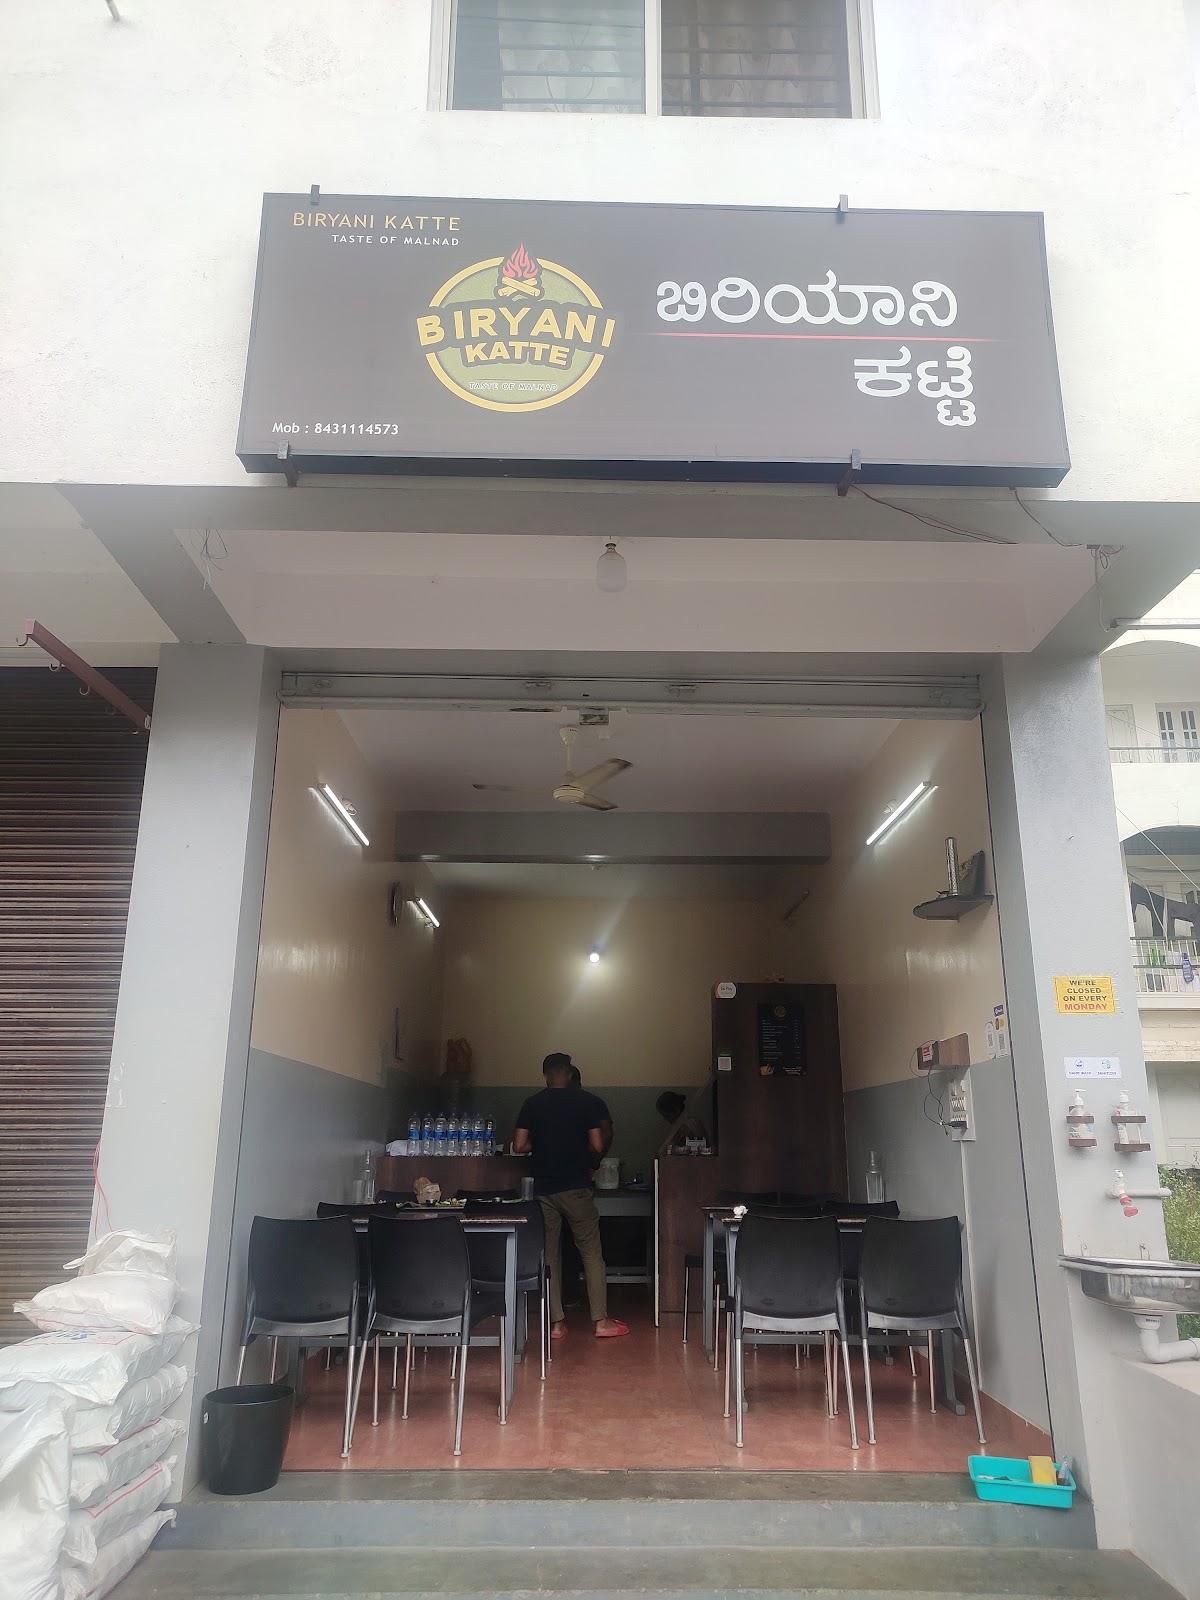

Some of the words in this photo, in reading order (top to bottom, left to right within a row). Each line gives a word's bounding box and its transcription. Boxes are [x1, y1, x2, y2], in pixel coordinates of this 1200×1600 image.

[293, 212, 374, 229] BIRYANI
[384, 215, 461, 231] KATTE
[331, 234, 373, 244] TASTE
[379, 235, 398, 244] OF
[403, 236, 459, 246] MALNAD
[656, 269, 958, 328] ಬಿರಿಯಾನಿ
[416, 306, 616, 348] BIRYANI
[465, 341, 570, 367] KATTE
[854, 345, 977, 427] ಕಟ್ಟೆ
[271, 422, 300, 434] Mob
[314, 422, 399, 435] 8431114573
[1064, 1003, 1108, 1011] MONDAY
